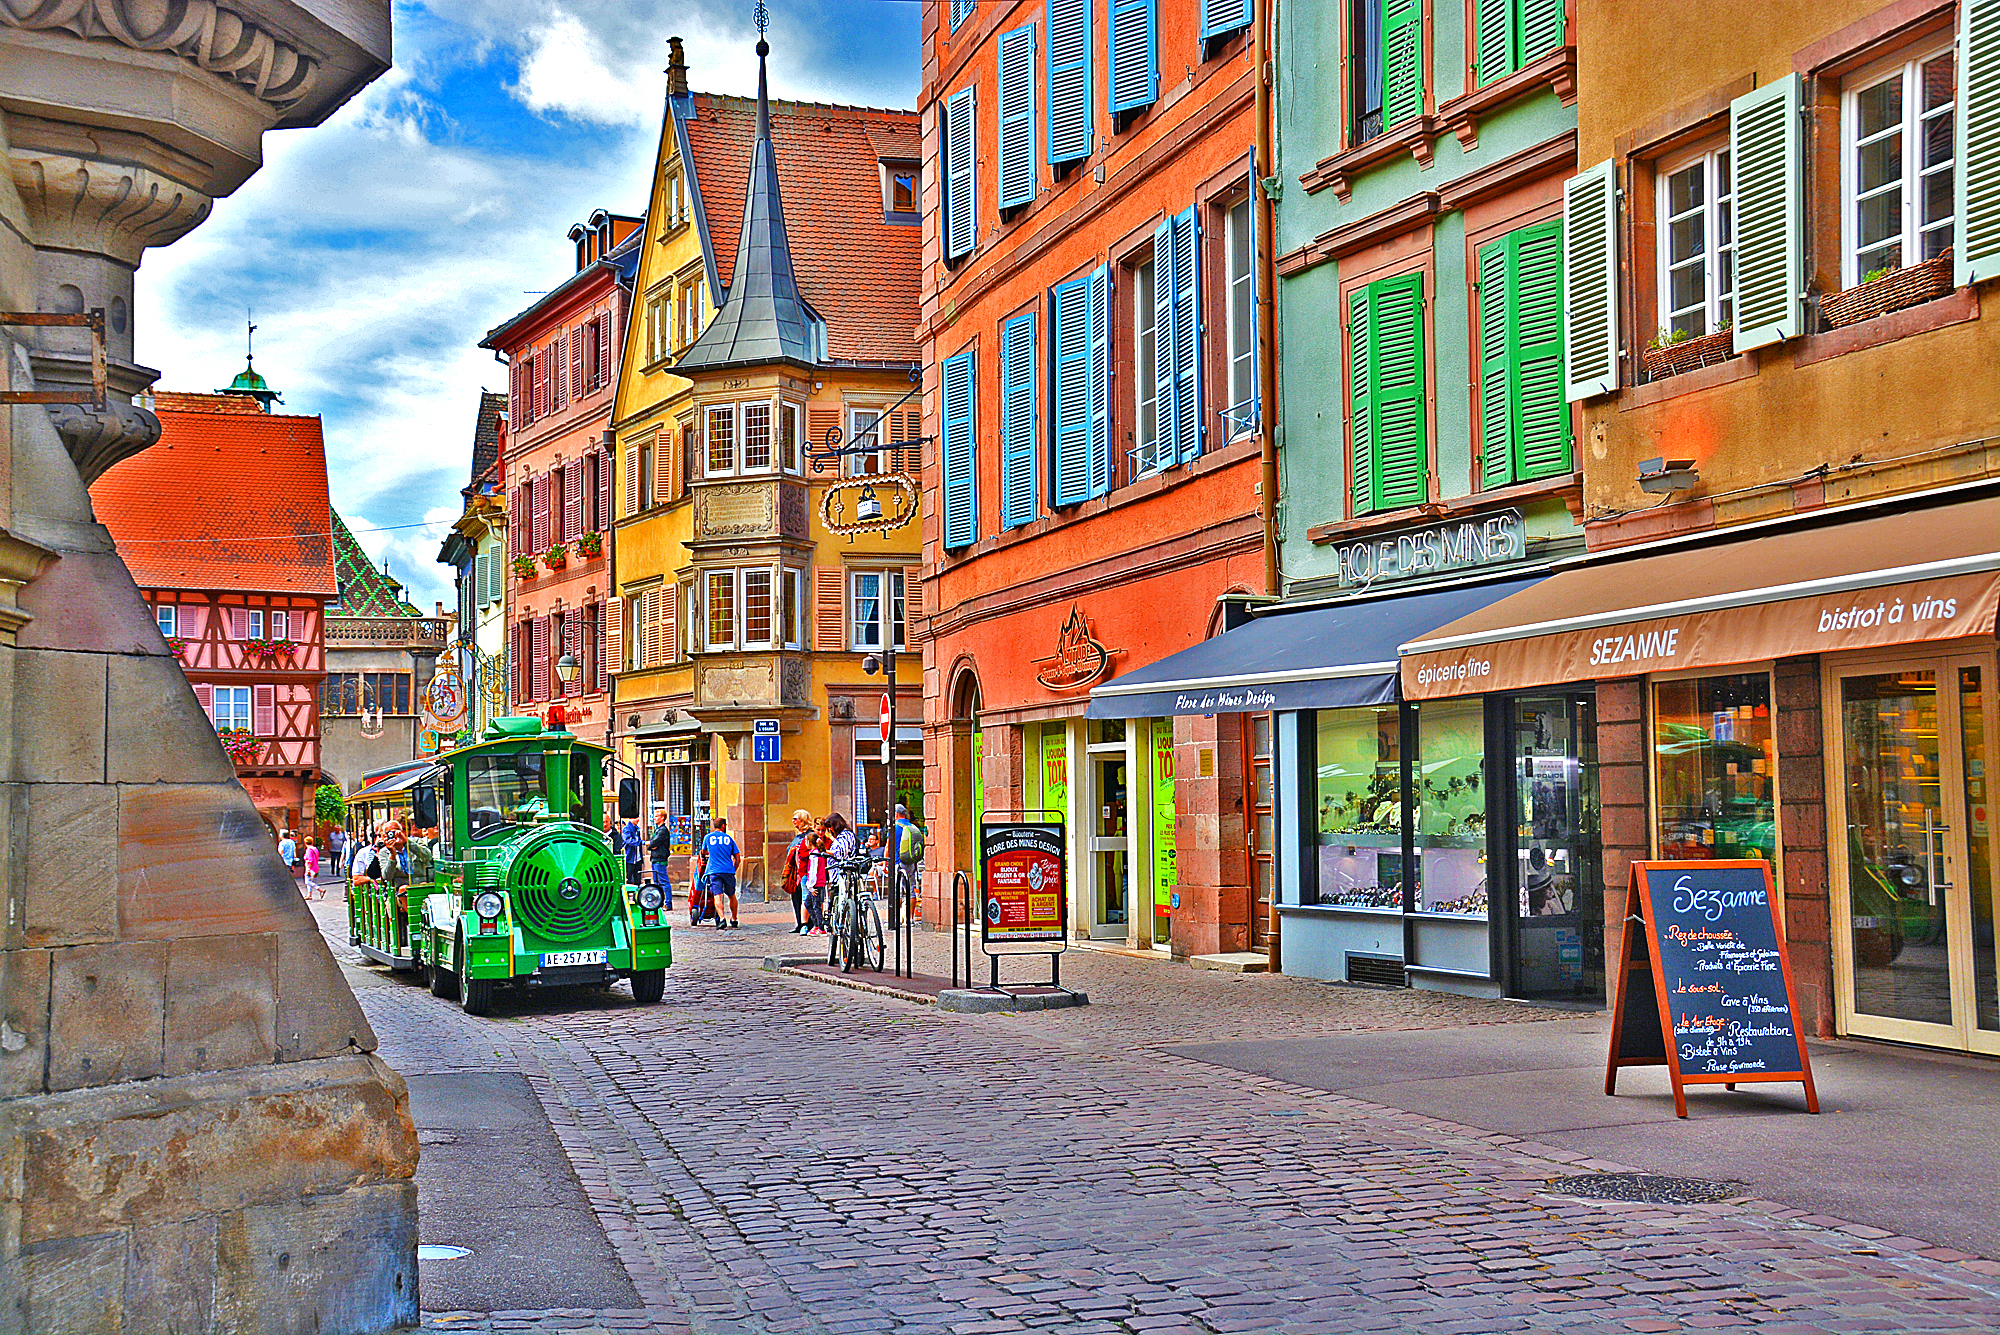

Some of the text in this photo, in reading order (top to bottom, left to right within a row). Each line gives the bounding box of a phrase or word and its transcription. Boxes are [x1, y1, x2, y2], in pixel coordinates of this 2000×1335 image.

[1398, 531, 1438, 571] DES
[1817, 595, 1957, 633] bistrot à vins
[1589, 628, 1680, 666] SEZANNE
[1417, 658, 1491, 687] épicerie fine
[1174, 689, 1276, 710] Flore des Mines Design
[1157, 736, 1174, 750] LIQUI
[1047, 759, 1067, 787] TOTA
[1158, 749, 1174, 781] TO
[1012, 830, 1034, 838] Bijouterie
[986, 838, 1060, 857] FLORE DES MINES DESIGN
[1673, 874, 1767, 922] Sezanne
[1669, 924, 1688, 947] Rez
[1688, 928, 1697, 940] de
[547, 951, 598, 965] AE-257-XY
[1697, 959, 1724, 971] Produits
[1677, 977, 1686, 993] Le
[1721, 994, 1740, 1007] Cave
[1749, 993, 1769, 1005] Vins
[1681, 1013, 1690, 1026] Le
[1727, 1020, 1792, 1037] Restauration
[1720, 1046, 1738, 1056] Vins
[1705, 1058, 1766, 1074] Pause Gourmande
